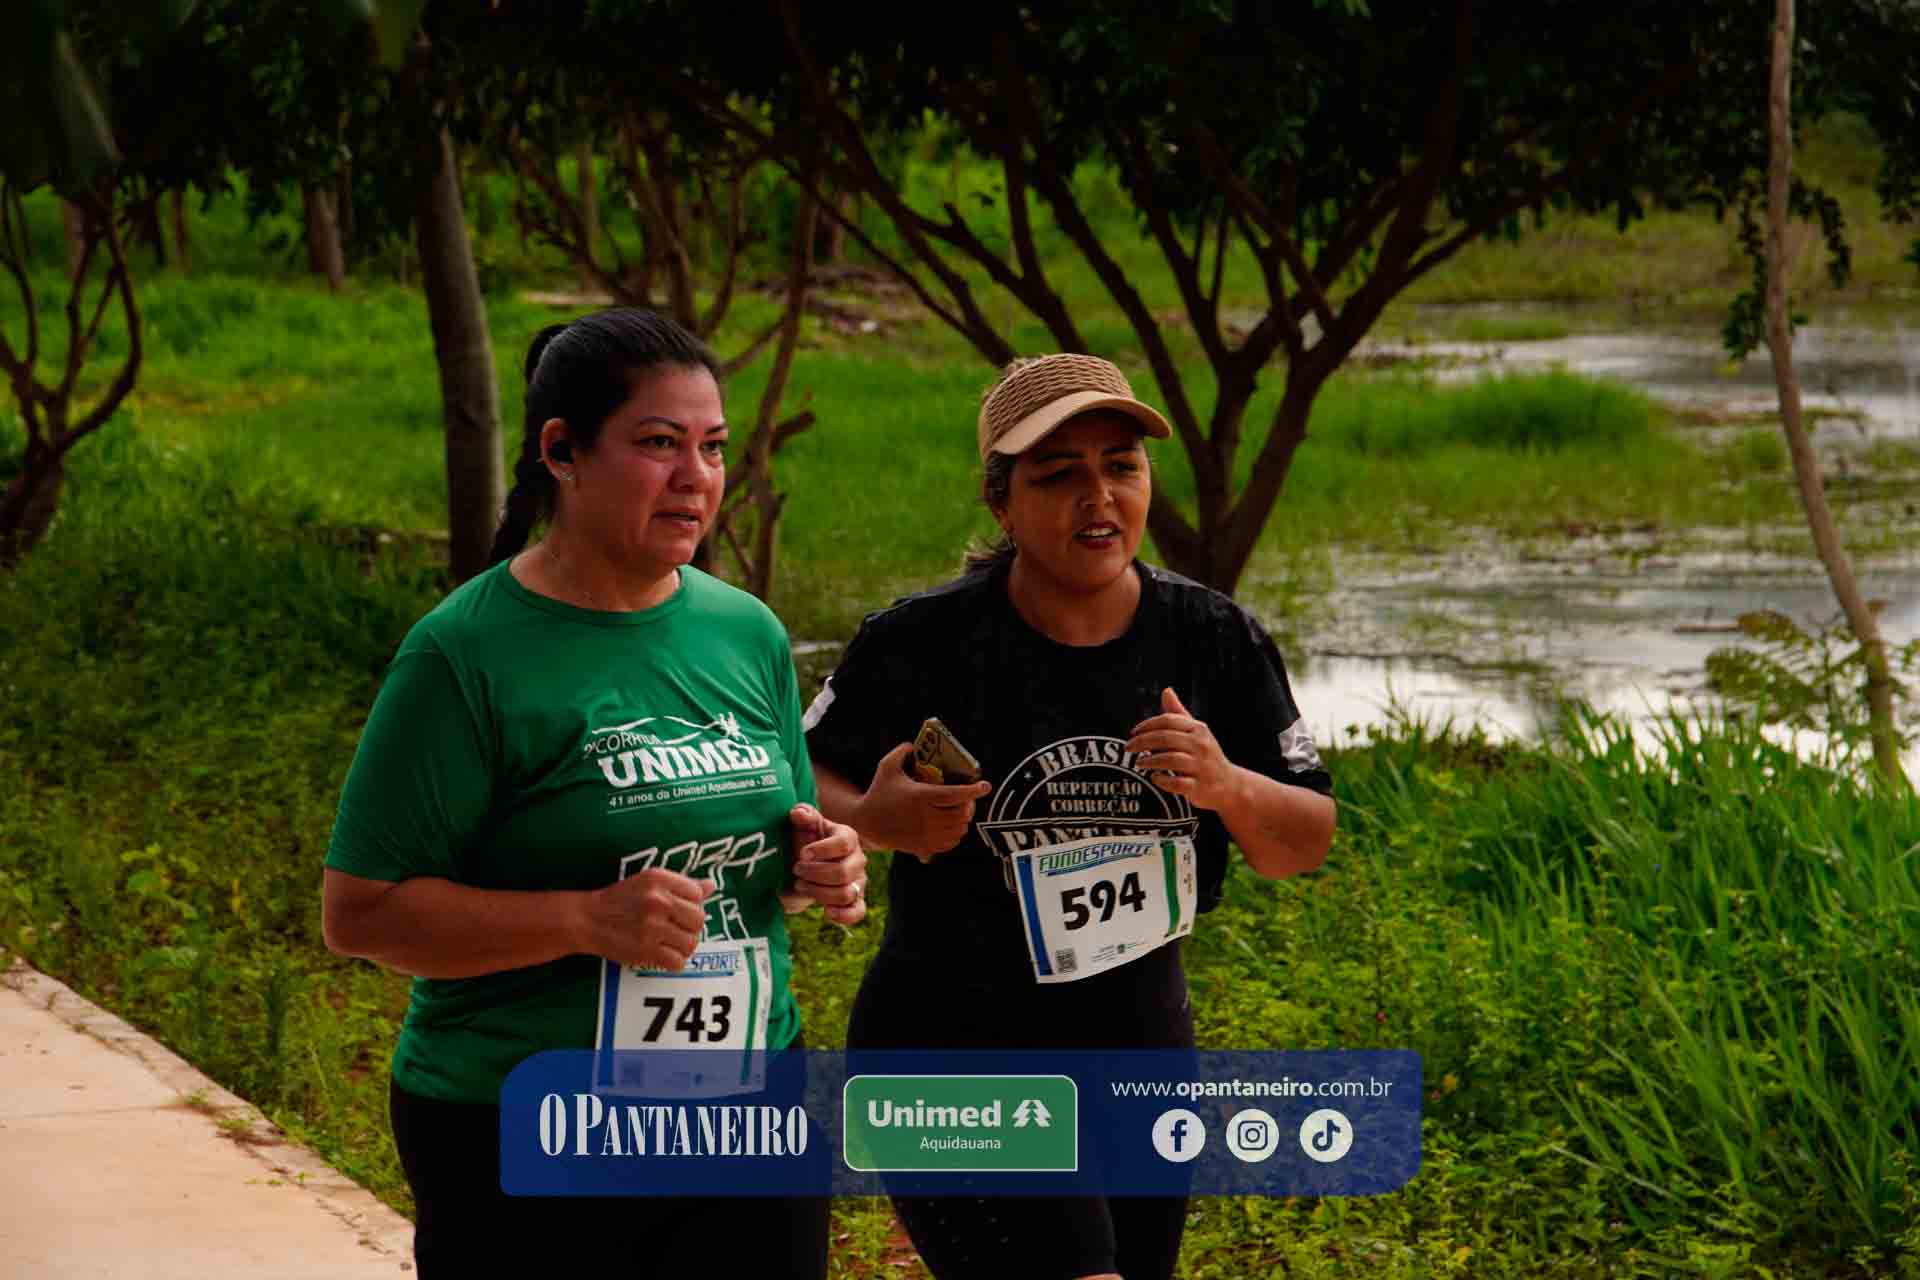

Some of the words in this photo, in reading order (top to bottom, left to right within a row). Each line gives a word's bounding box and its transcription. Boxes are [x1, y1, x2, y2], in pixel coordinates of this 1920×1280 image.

[598, 739, 770, 788] UNIMED
[627, 789, 652, 805] anos
[656, 786, 670, 801] da
[672, 782, 706, 799] Unimed
[1046, 777, 1142, 797] REPETIÇÃO
[1050, 796, 1140, 816] CORREÇÃO
[1039, 841, 1155, 873] FUNDESPORTE
[1060, 872, 1147, 931] 594
[642, 995, 732, 1043] 743
